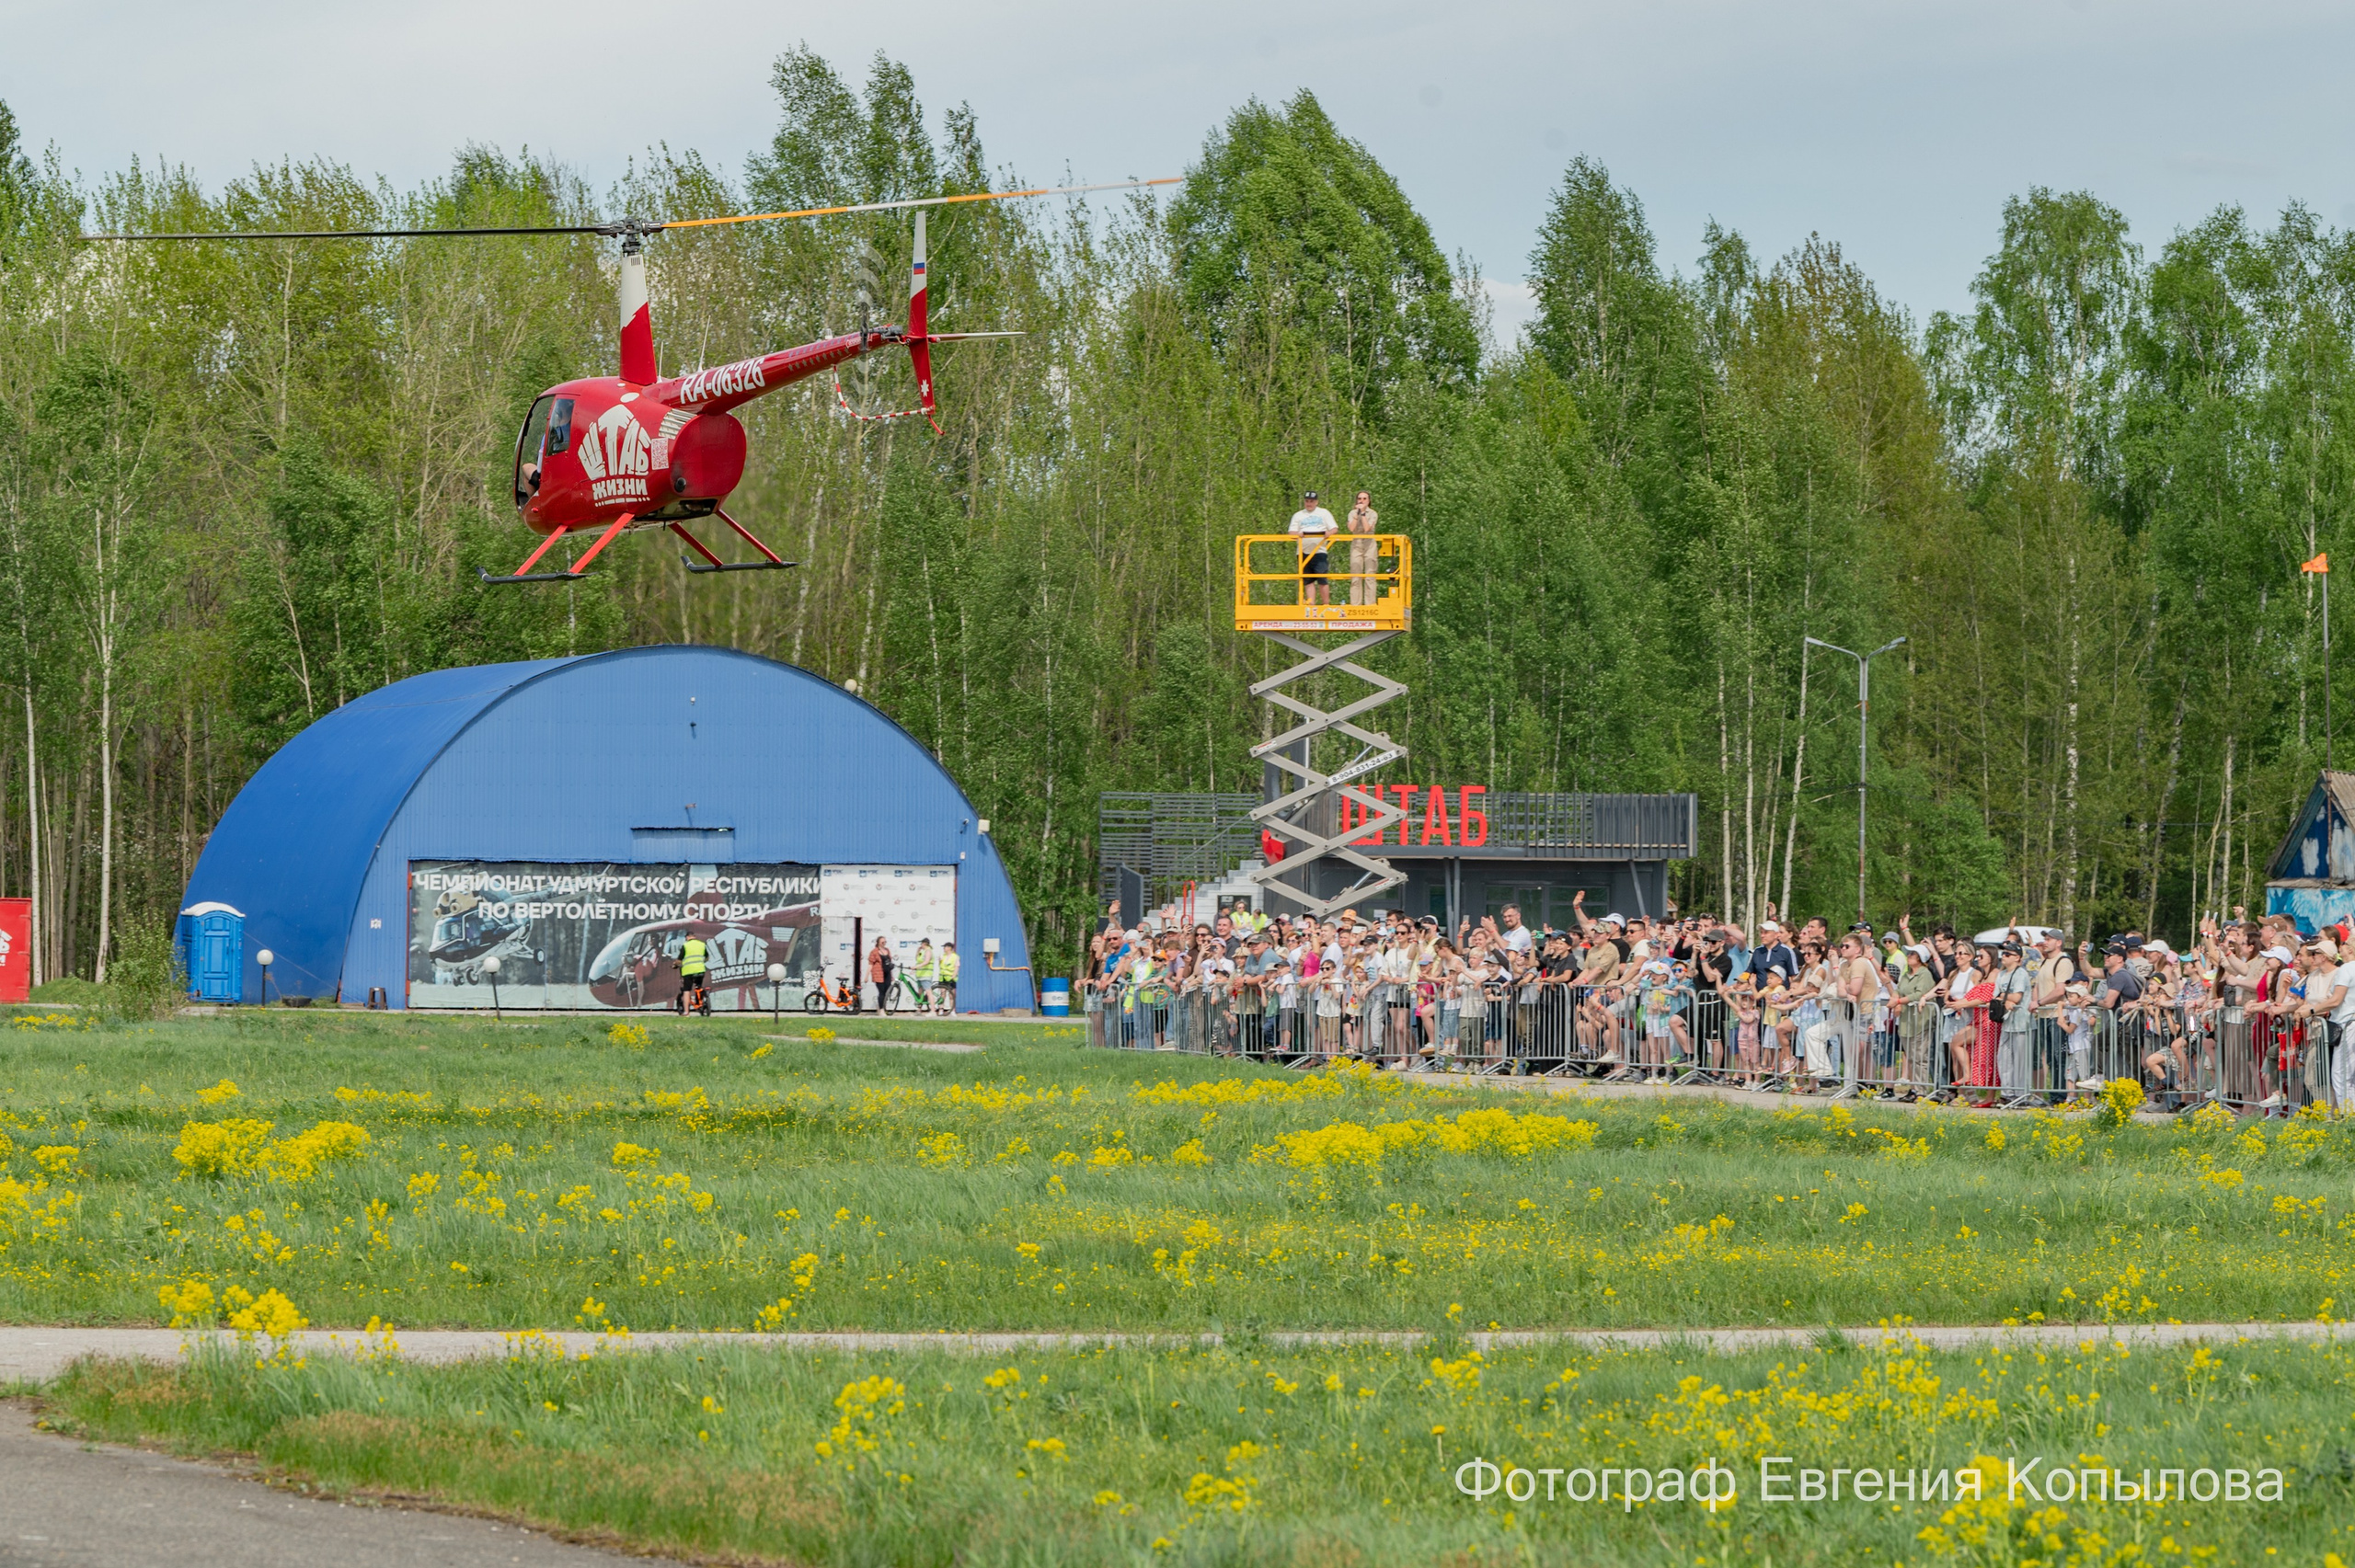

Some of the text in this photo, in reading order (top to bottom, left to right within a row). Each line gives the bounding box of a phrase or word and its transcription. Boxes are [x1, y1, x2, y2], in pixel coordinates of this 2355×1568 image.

[681, 357, 766, 405] RA-06326
[578, 404, 651, 481] ШТАБ
[592, 478, 648, 500] ЖИЗНИ
[1341, 784, 1488, 847] ШТАБ
[417, 874, 547, 892] ЧЕМПИОНАТ
[550, 872, 685, 895] УДМУРТСКОЙ
[478, 898, 770, 921] ПО ВЕРТОЛЁТНОМУ СПОРТУ
[710, 963, 765, 980] ЖИЗНИ
